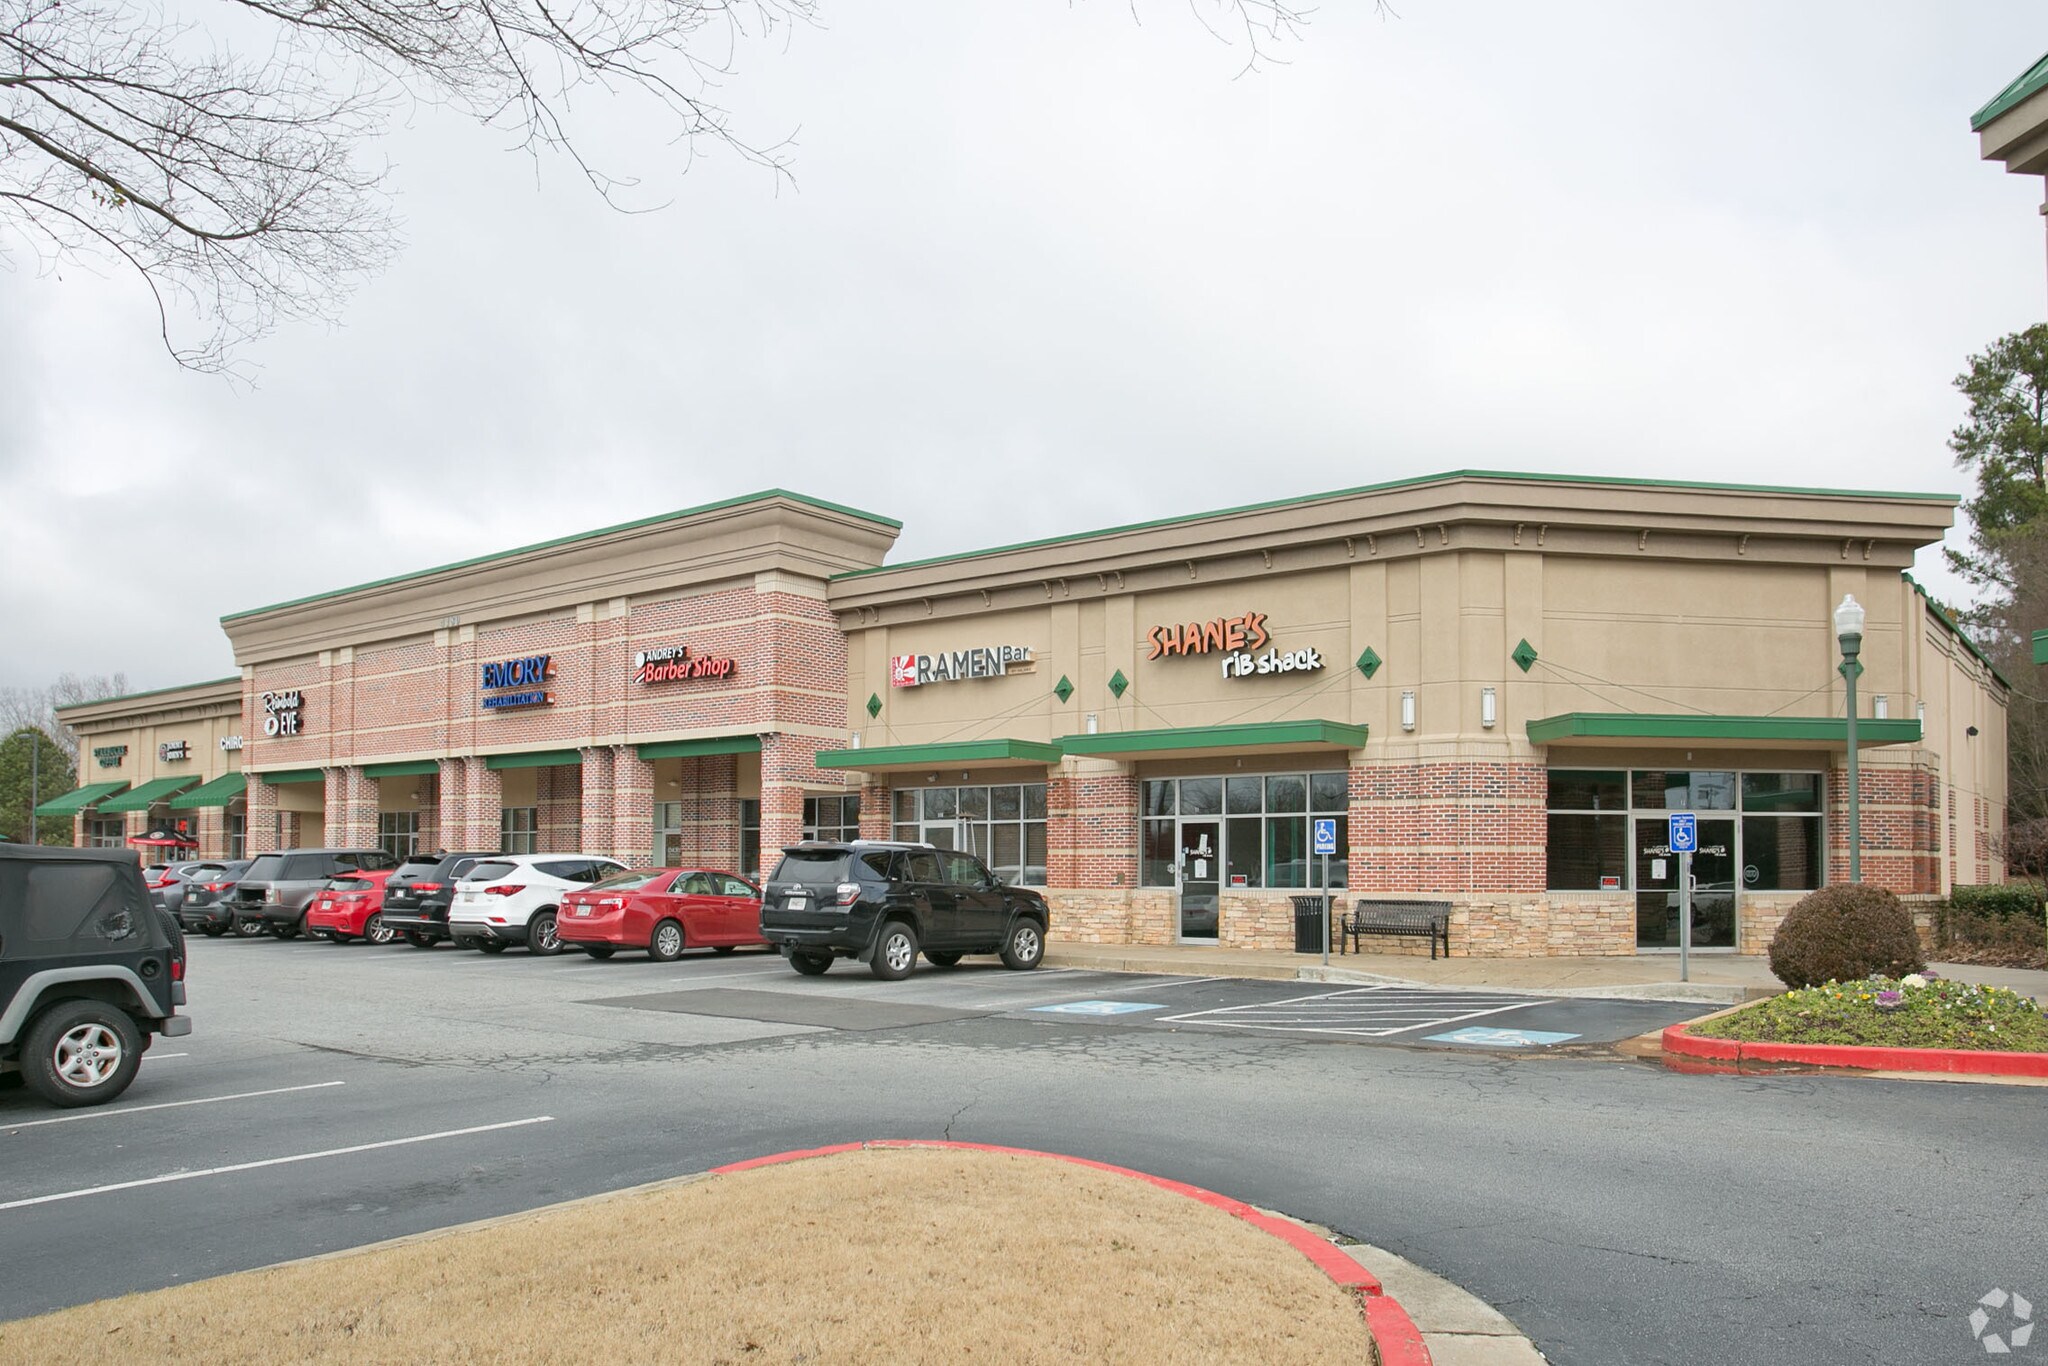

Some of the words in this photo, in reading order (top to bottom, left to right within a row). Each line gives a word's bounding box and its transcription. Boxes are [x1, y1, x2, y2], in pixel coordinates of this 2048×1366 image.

[1147, 611, 1267, 660] SHANE'S
[646, 646, 684, 662] ANDREY'S
[917, 646, 1001, 682] RAMEN
[1003, 645, 1029, 662] Bar
[1257, 648, 1321, 674] shack
[481, 655, 549, 690] EMORY
[645, 659, 692, 682] Barber
[692, 655, 731, 679] Shop
[482, 691, 545, 709] REHABILITATION
[280, 711, 297, 735] EYE
[220, 735, 243, 751] CHIRO
